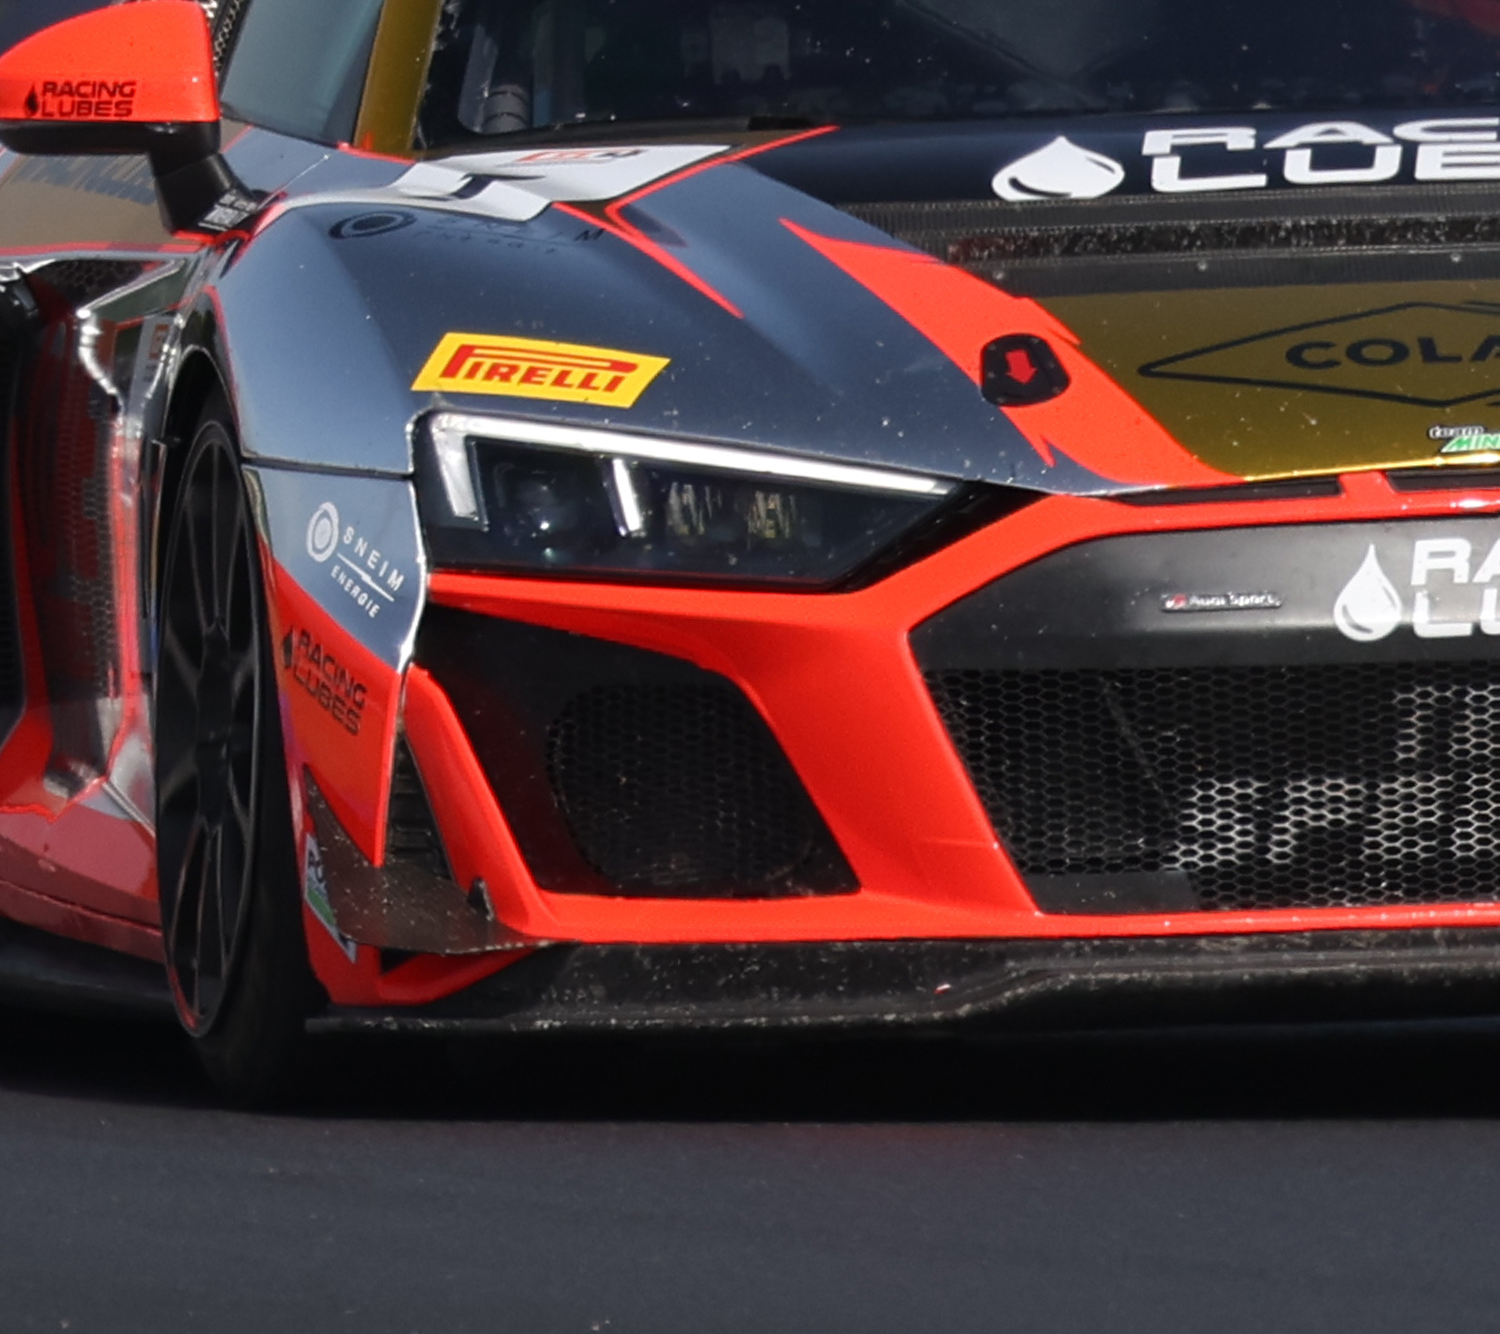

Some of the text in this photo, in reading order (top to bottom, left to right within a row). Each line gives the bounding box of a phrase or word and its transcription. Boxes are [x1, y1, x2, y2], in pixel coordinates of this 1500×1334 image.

[41, 80, 137, 99] RACING
[41, 99, 134, 118] LUBES
[439, 343, 639, 394] PIRELLI
[343, 525, 405, 592] SNEIM
[329, 565, 381, 619] ENERGIE
[298, 627, 368, 710] RACING
[293, 664, 361, 737] LUBES
